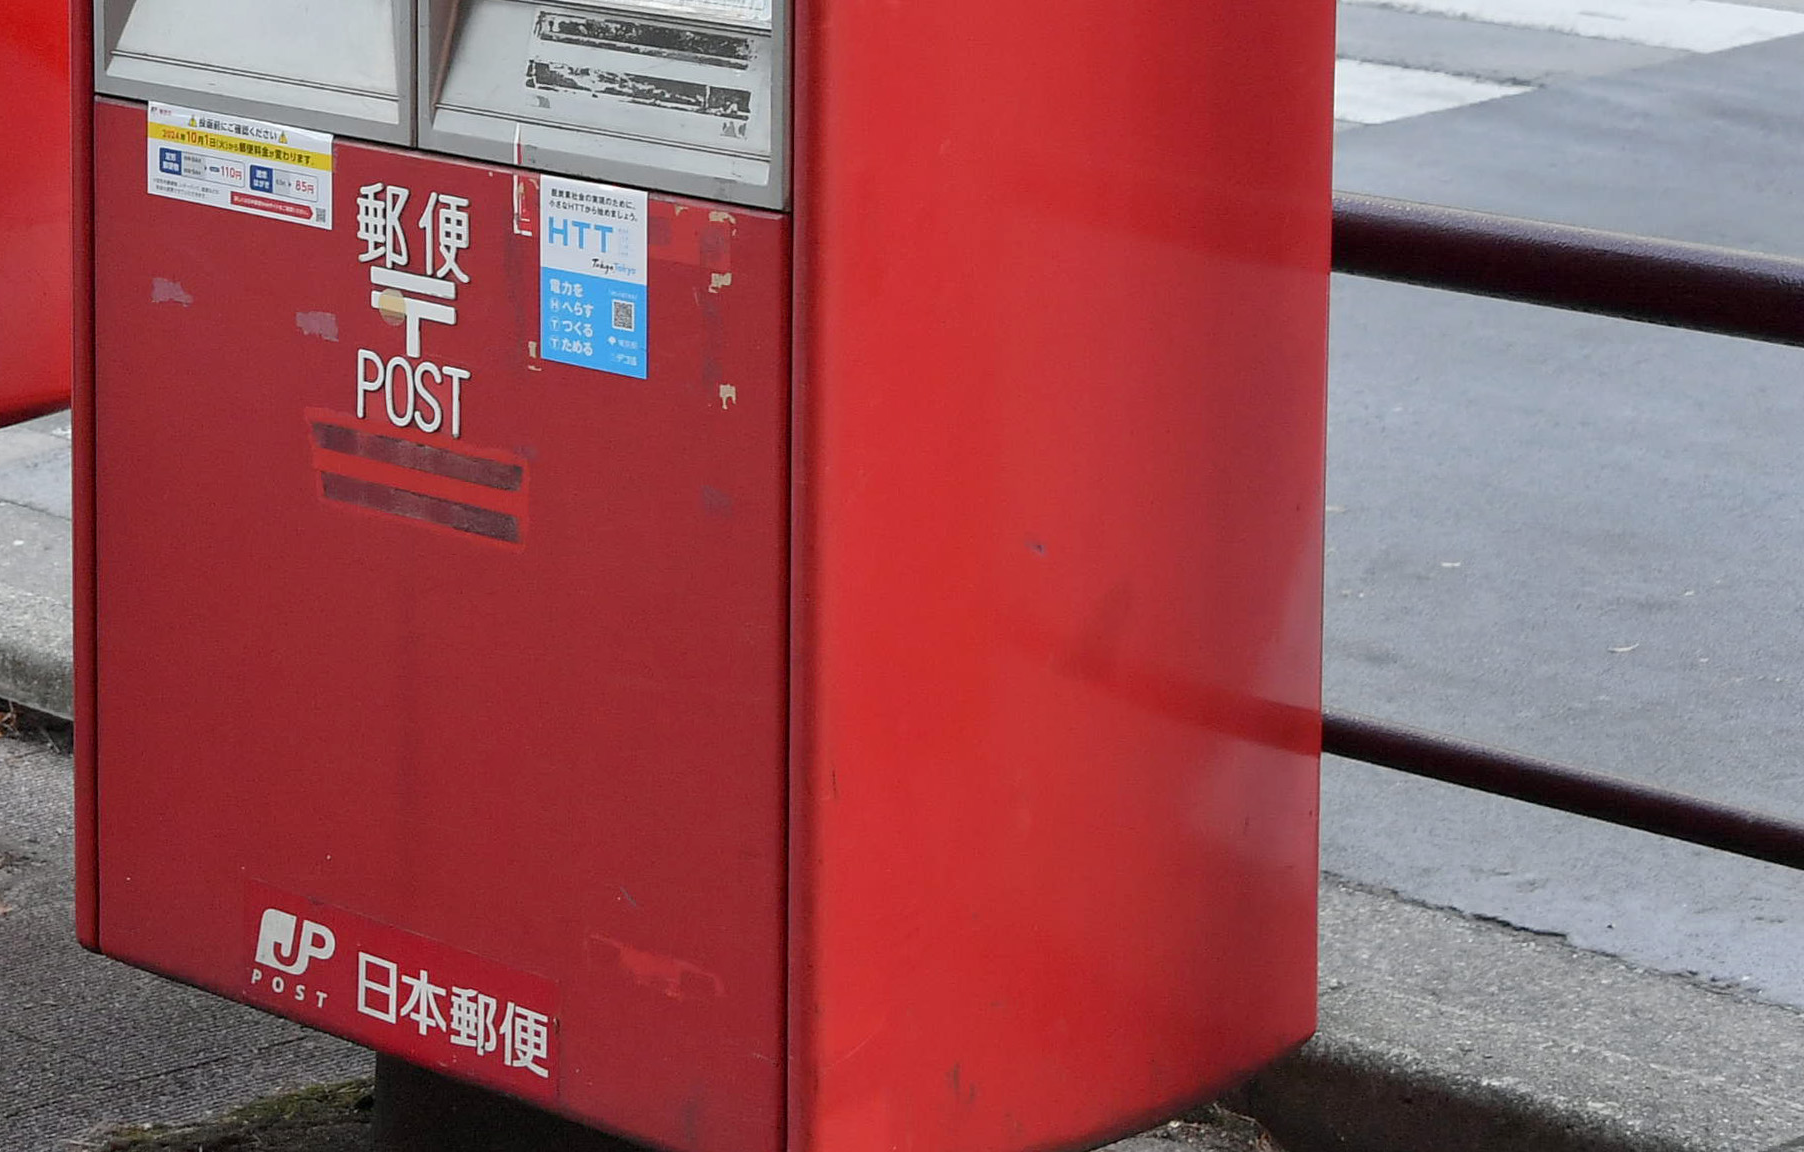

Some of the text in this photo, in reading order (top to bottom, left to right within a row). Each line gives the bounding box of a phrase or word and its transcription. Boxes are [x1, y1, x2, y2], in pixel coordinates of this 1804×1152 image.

[220, 165, 243, 181] 110円
[294, 179, 315, 195] 85円
[356, 182, 471, 284] 郵便
[548, 216, 614, 254] HTT
[549, 278, 585, 298] 電力を
[562, 301, 595, 319] へらす
[562, 320, 594, 338] つくる
[562, 337, 594, 357] ためる
[356, 347, 472, 440] POST
[254, 907, 336, 976] JP
[250, 968, 329, 1009] POST
[356, 950, 550, 1079] 日本郵便
